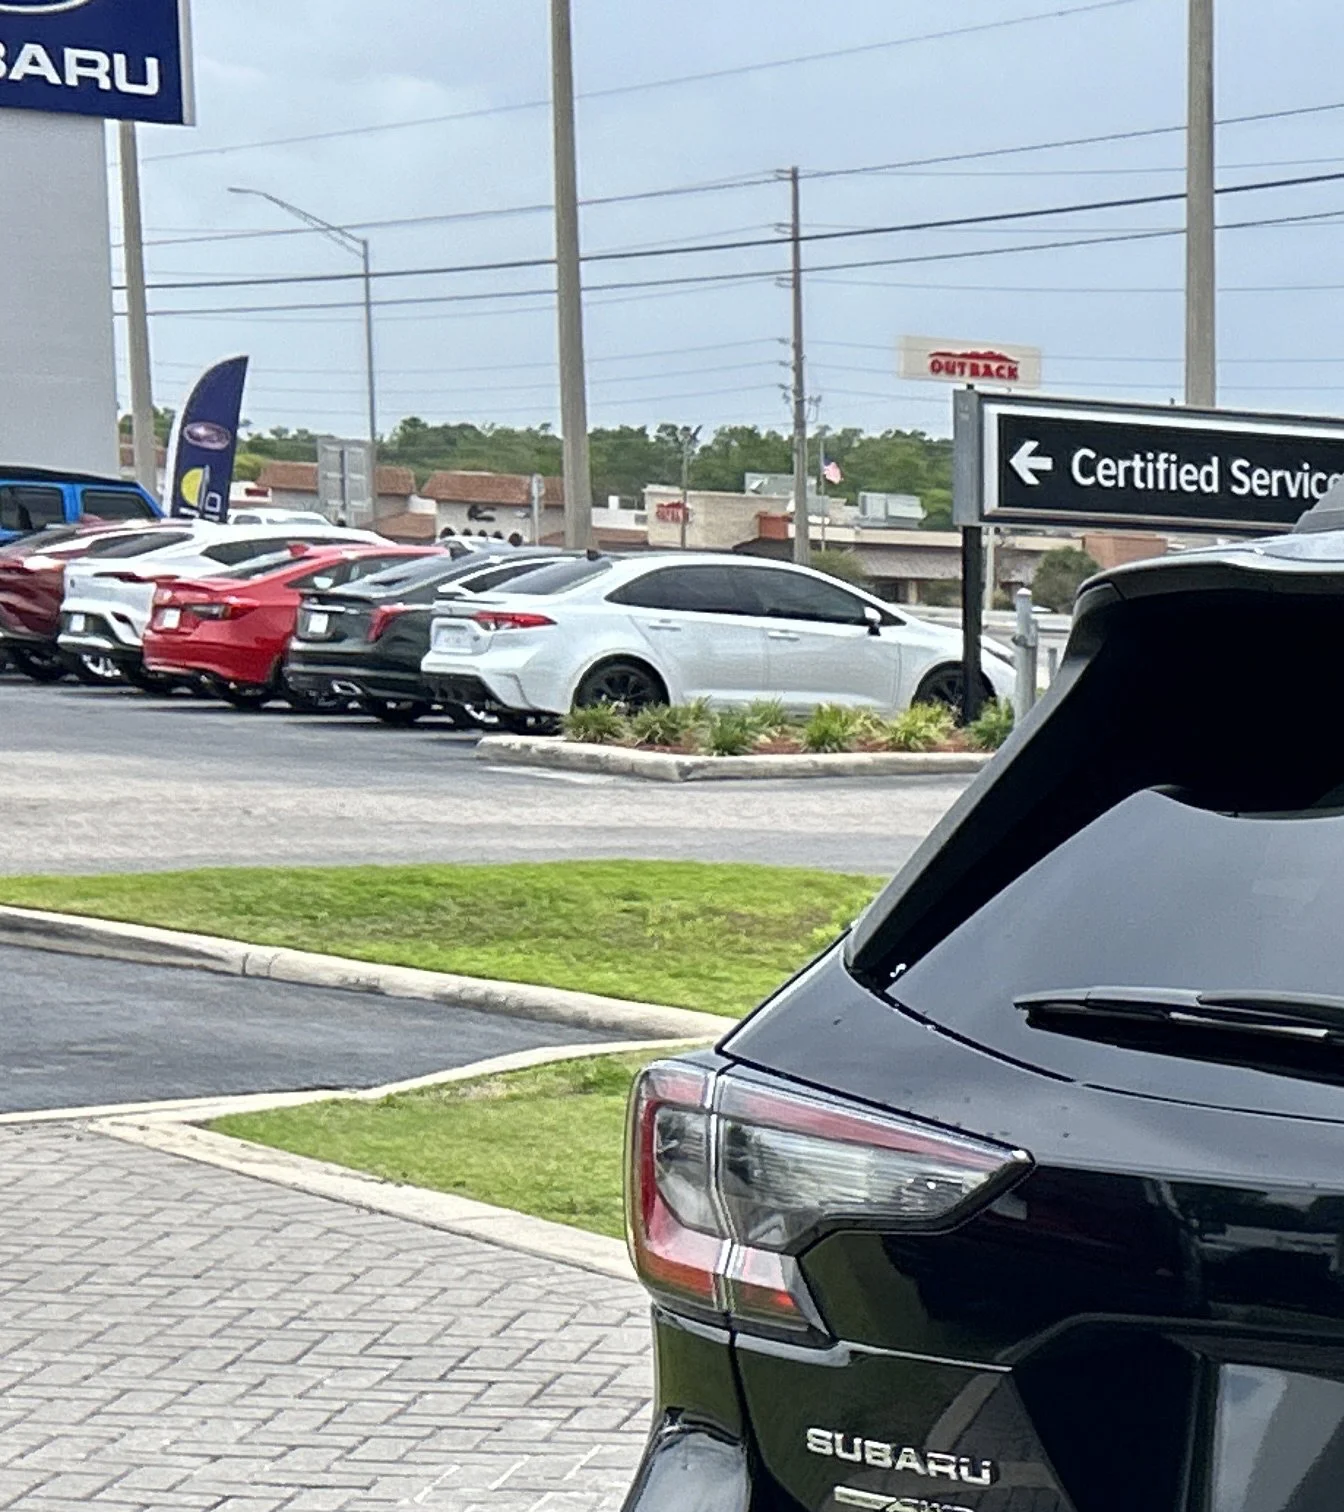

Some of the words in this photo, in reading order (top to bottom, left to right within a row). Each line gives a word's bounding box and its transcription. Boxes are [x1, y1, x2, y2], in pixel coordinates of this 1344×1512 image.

[0, 42, 160, 96] ARU
[930, 359, 1020, 380] OUTBACK
[1071, 447, 1219, 494] Certified
[806, 1427, 993, 1486] SUBARU
